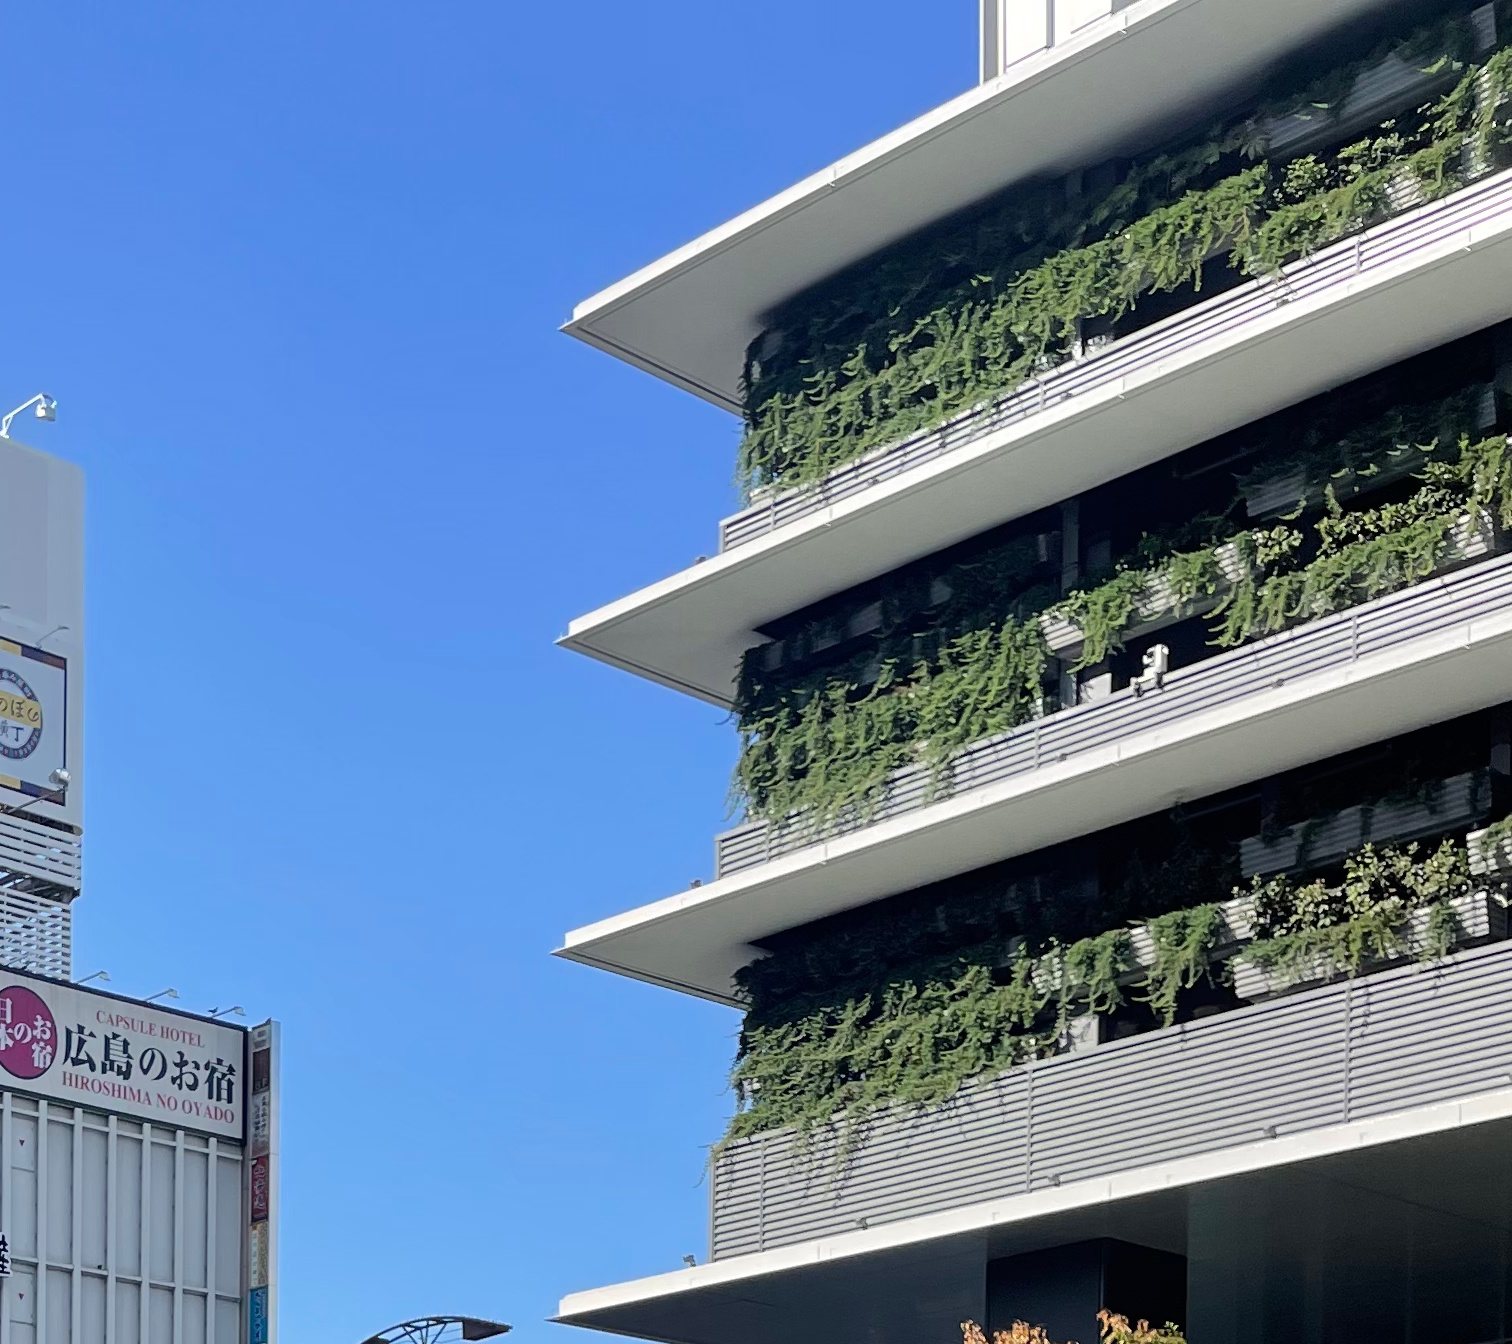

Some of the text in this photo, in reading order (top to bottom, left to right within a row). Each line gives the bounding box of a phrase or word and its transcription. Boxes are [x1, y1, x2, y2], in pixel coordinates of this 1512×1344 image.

[96, 1010, 205, 1048] CAPSULE HOTEL
[62, 1024, 236, 1104] 広島のお宿
[62, 1071, 152, 1106] HIROSHIMA
[156, 1093, 178, 1111] NO
[182, 1099, 235, 1124] OYADO
